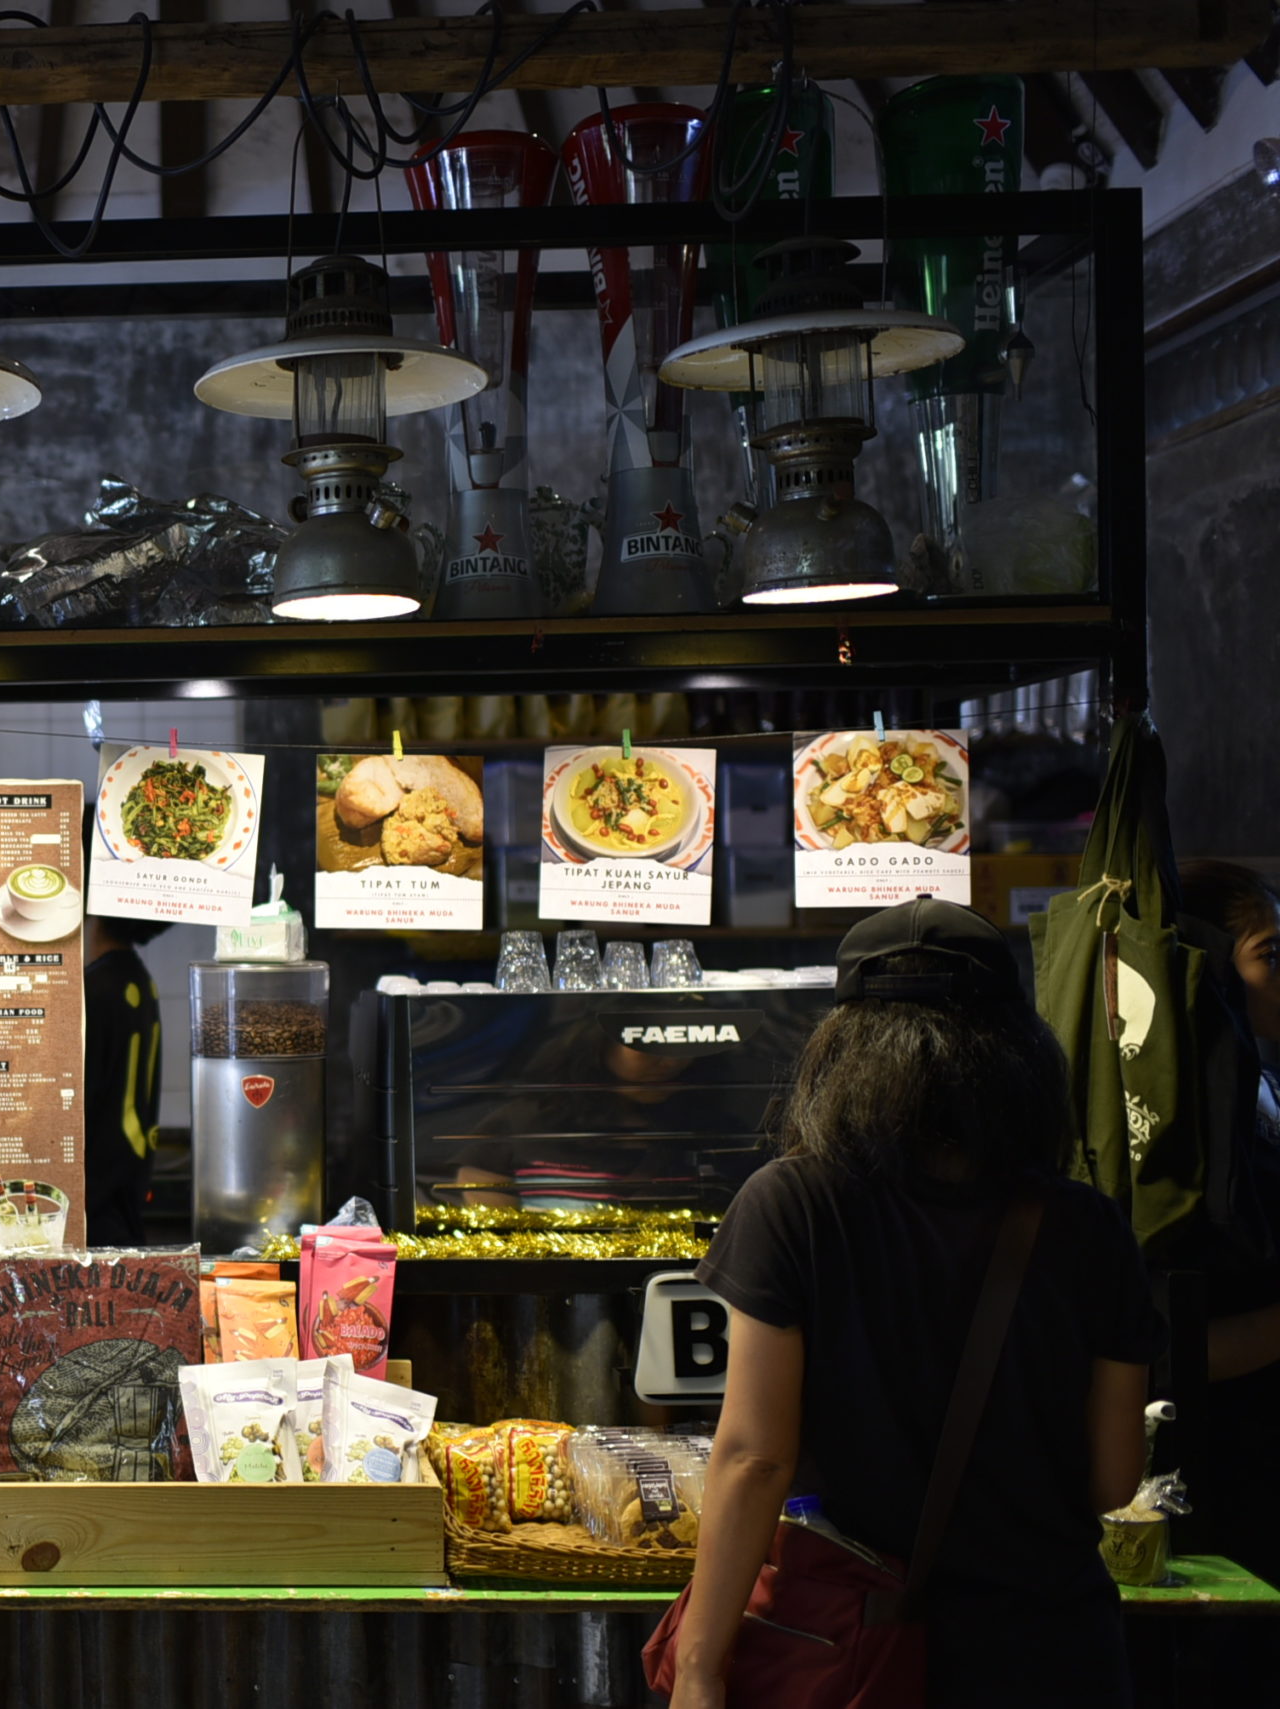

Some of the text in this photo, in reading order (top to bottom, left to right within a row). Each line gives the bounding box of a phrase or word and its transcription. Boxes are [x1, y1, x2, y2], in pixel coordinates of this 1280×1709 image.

[449, 557, 527, 578] BINTANG
[13, 797, 47, 805] DRINK
[834, 856, 934, 866] GADO GADO
[136, 872, 208, 885] SAYUR GONDE
[564, 867, 690, 881] TIPAT KUAH SAYUR
[360, 879, 441, 889] TIPAT TUM
[601, 880, 652, 891] JEPANG
[869, 893, 899, 901] SANUR
[117, 897, 223, 912] WARUNG BHINEKA MUDA
[612, 901, 652, 909] BHINEKA
[154, 907, 183, 916] SANUR
[387, 909, 425, 917] BHINEKA
[35, 954, 60, 962] RICE
[19, 1008, 44, 1016] FOOD
[621, 1025, 740, 1044] FAEMA
[111, 1263, 193, 1312] DJAJA
[66, 1301, 115, 1327] BALI
[340, 1324, 386, 1341] BALADO
